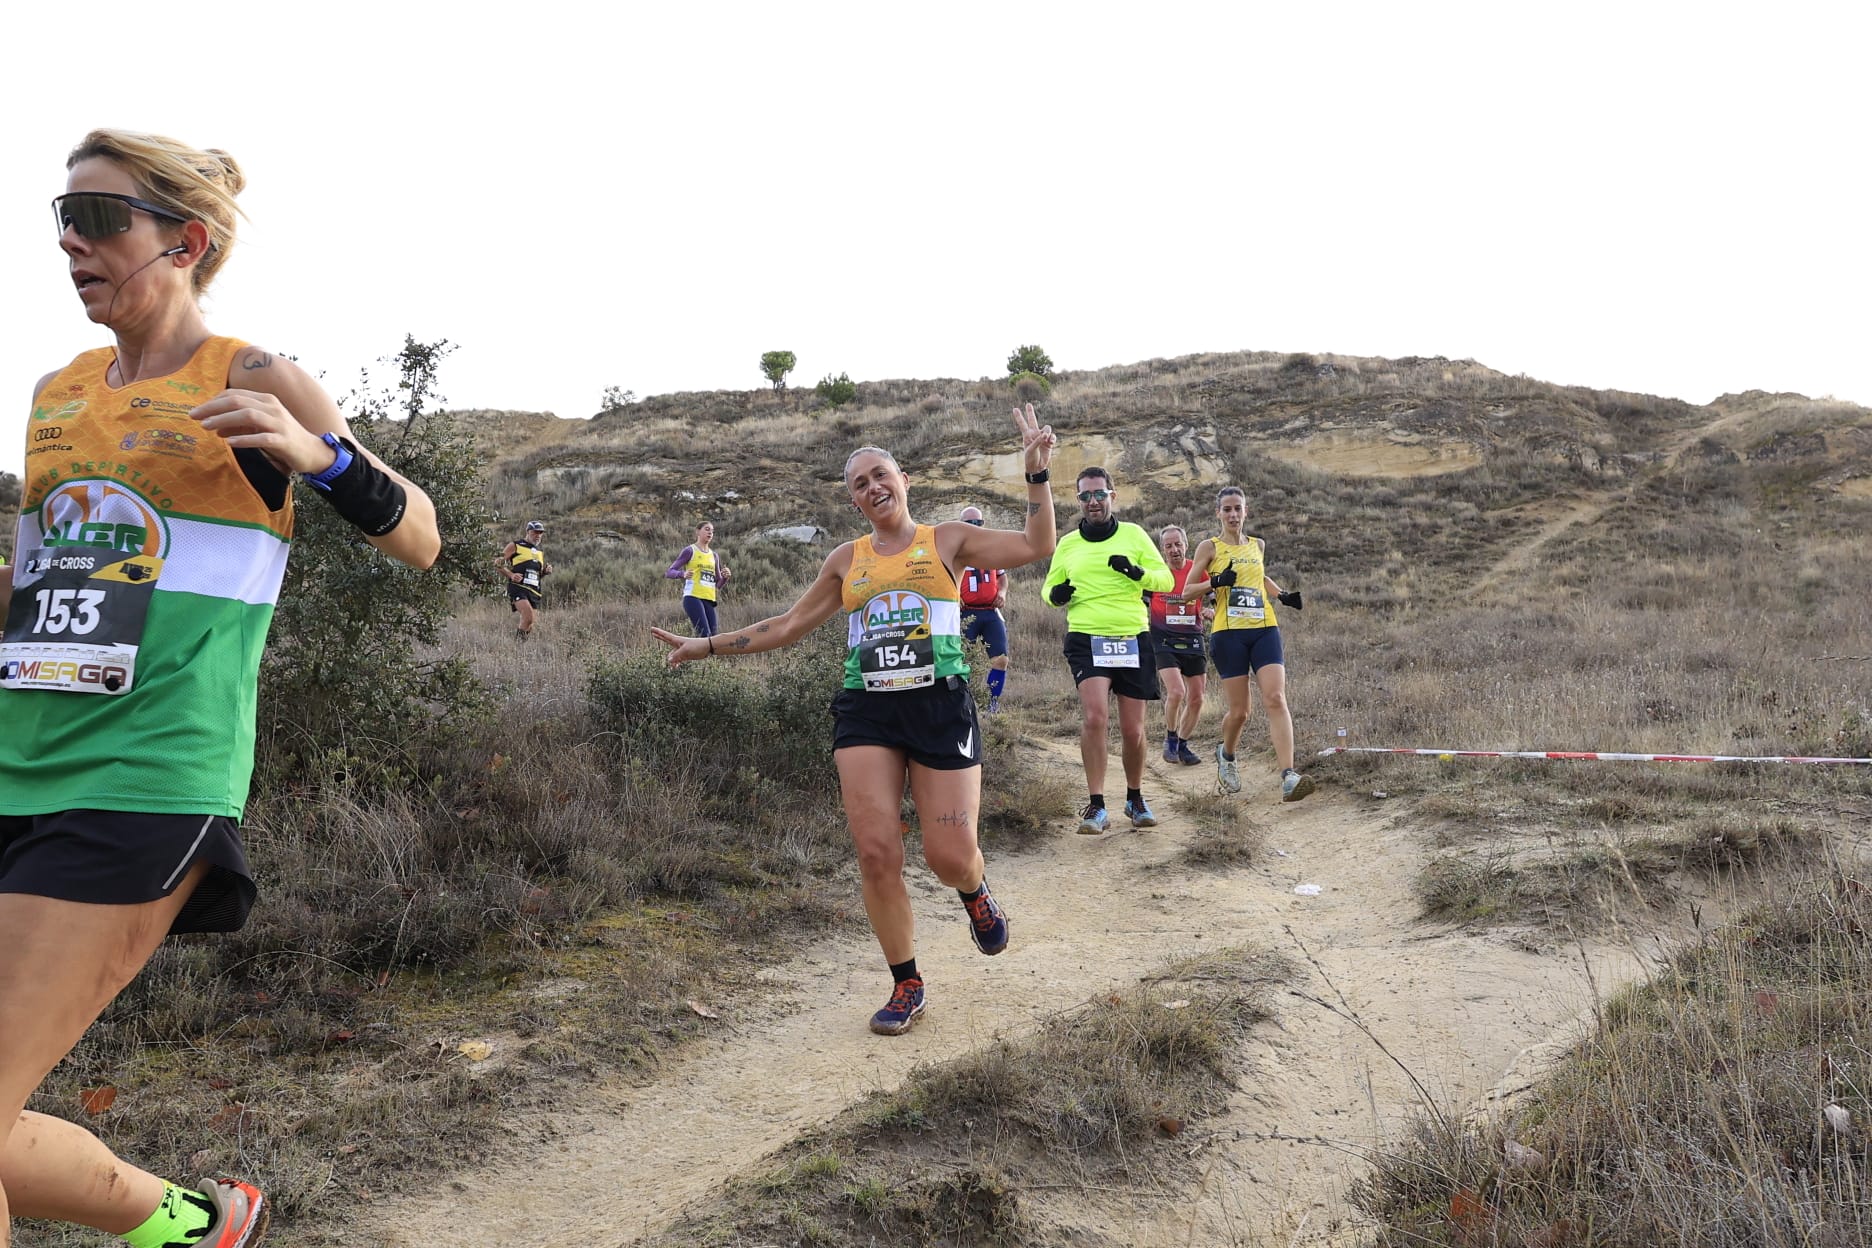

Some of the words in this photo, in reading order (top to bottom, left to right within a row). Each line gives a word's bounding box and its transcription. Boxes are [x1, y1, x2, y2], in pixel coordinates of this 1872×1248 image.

[131, 397, 151, 408] ce
[152, 401, 197, 411] consultin
[60, 557, 95, 570] CROSS
[32, 589, 106, 635] 153
[869, 607, 925, 627] ALCER
[1178, 605, 1186, 615] 3
[886, 630, 905, 638] CROSS
[1102, 641, 1128, 654] 515
[875, 645, 917, 668] 154
[5, 660, 127, 686] OMISAGA
[868, 674, 932, 688] OMISAG
